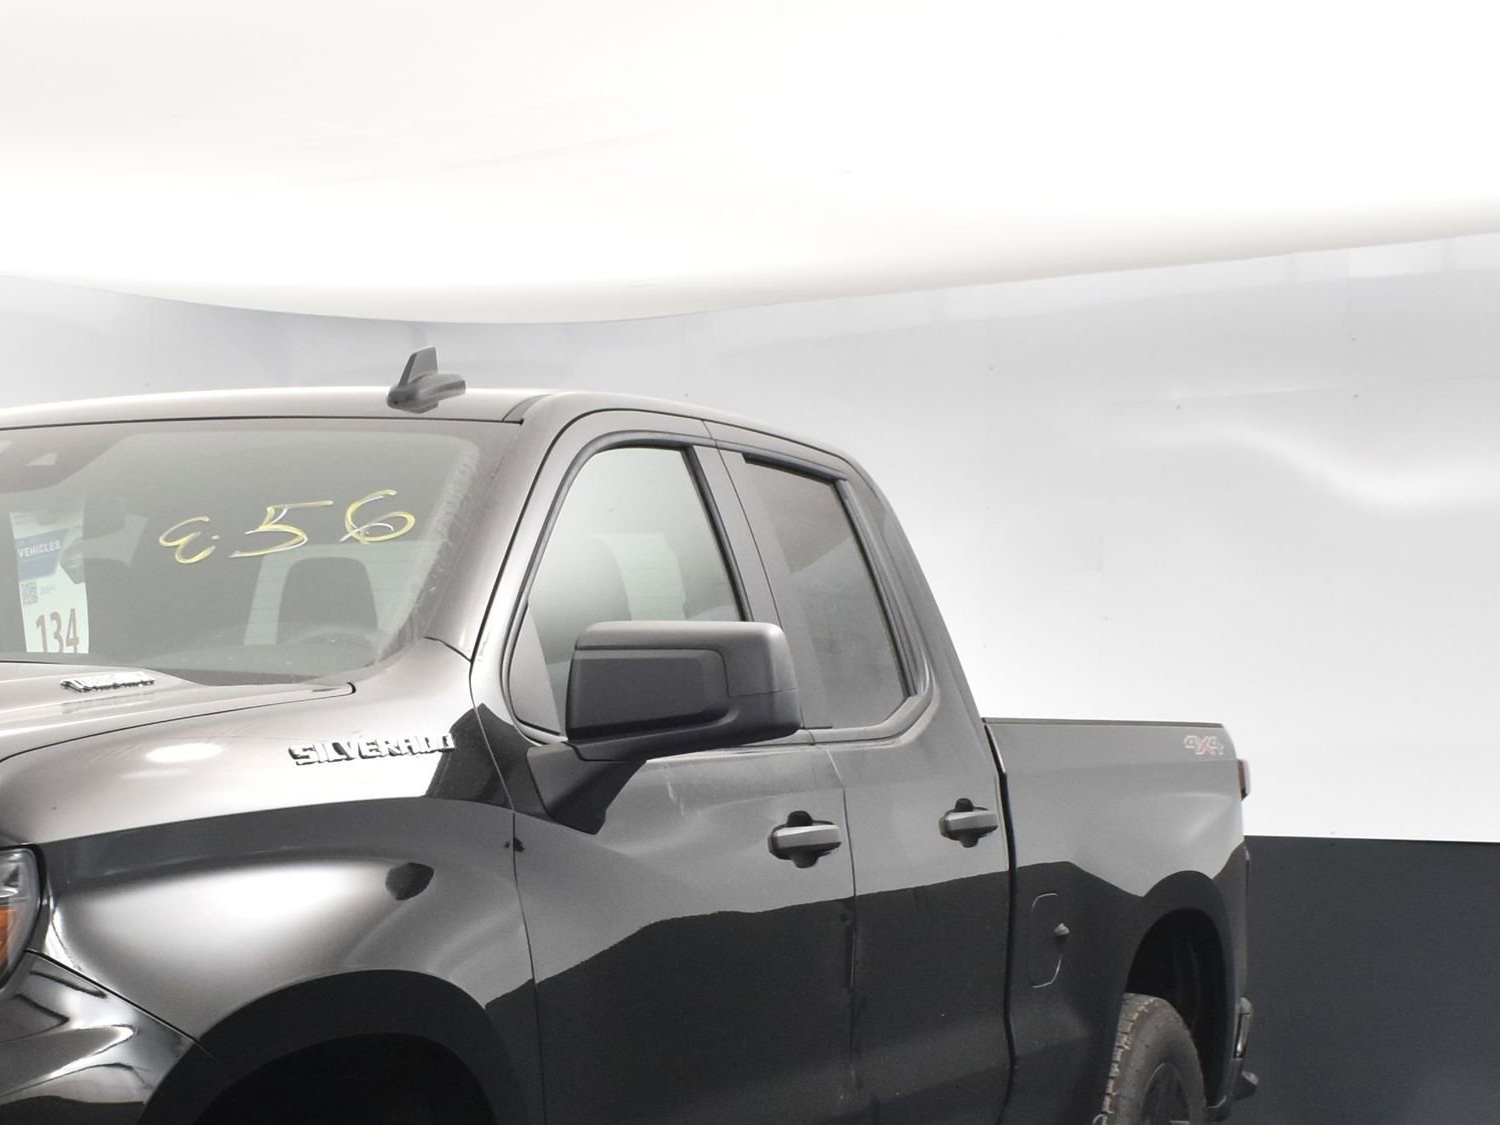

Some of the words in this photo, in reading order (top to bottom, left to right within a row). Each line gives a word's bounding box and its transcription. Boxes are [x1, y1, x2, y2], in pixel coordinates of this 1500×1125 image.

[18, 540, 61, 558] VEHICLES
[36, 608, 80, 653] 134
[287, 732, 456, 766] SILVERADO
